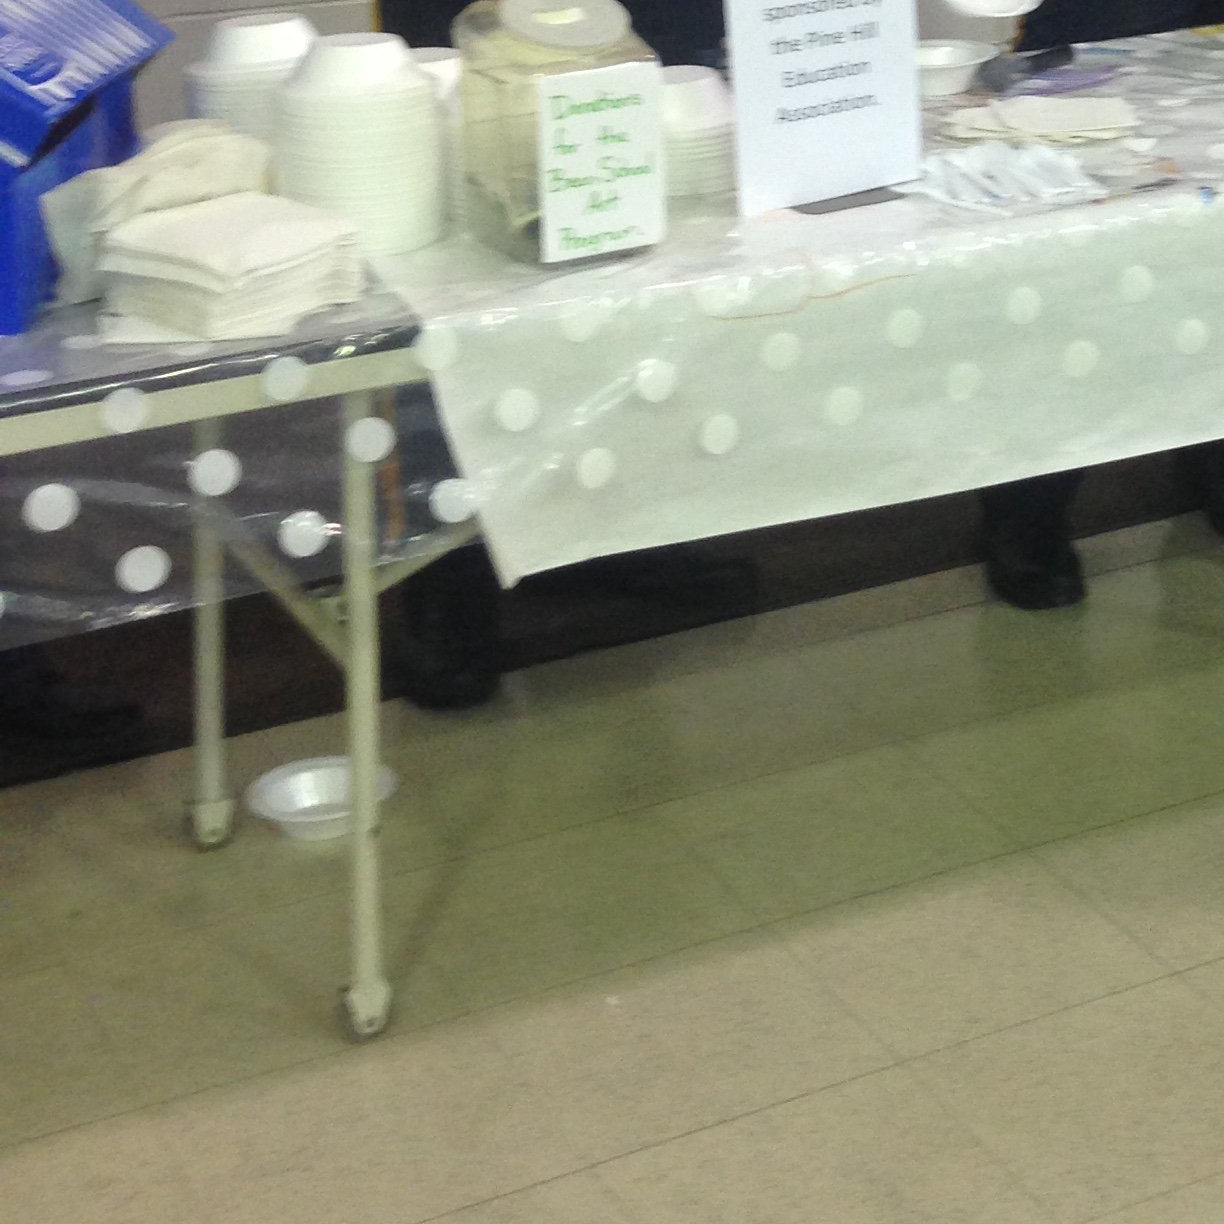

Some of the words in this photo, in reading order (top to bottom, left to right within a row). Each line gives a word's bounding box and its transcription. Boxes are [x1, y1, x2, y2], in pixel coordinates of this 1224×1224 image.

[769, 37, 802, 56] the
[803, 29, 847, 50] Pine
[849, 20, 880, 42] Hill
[781, 61, 873, 88] Education
[549, 92, 643, 120] Donations
[553, 127, 581, 155] for
[595, 126, 629, 144] the
